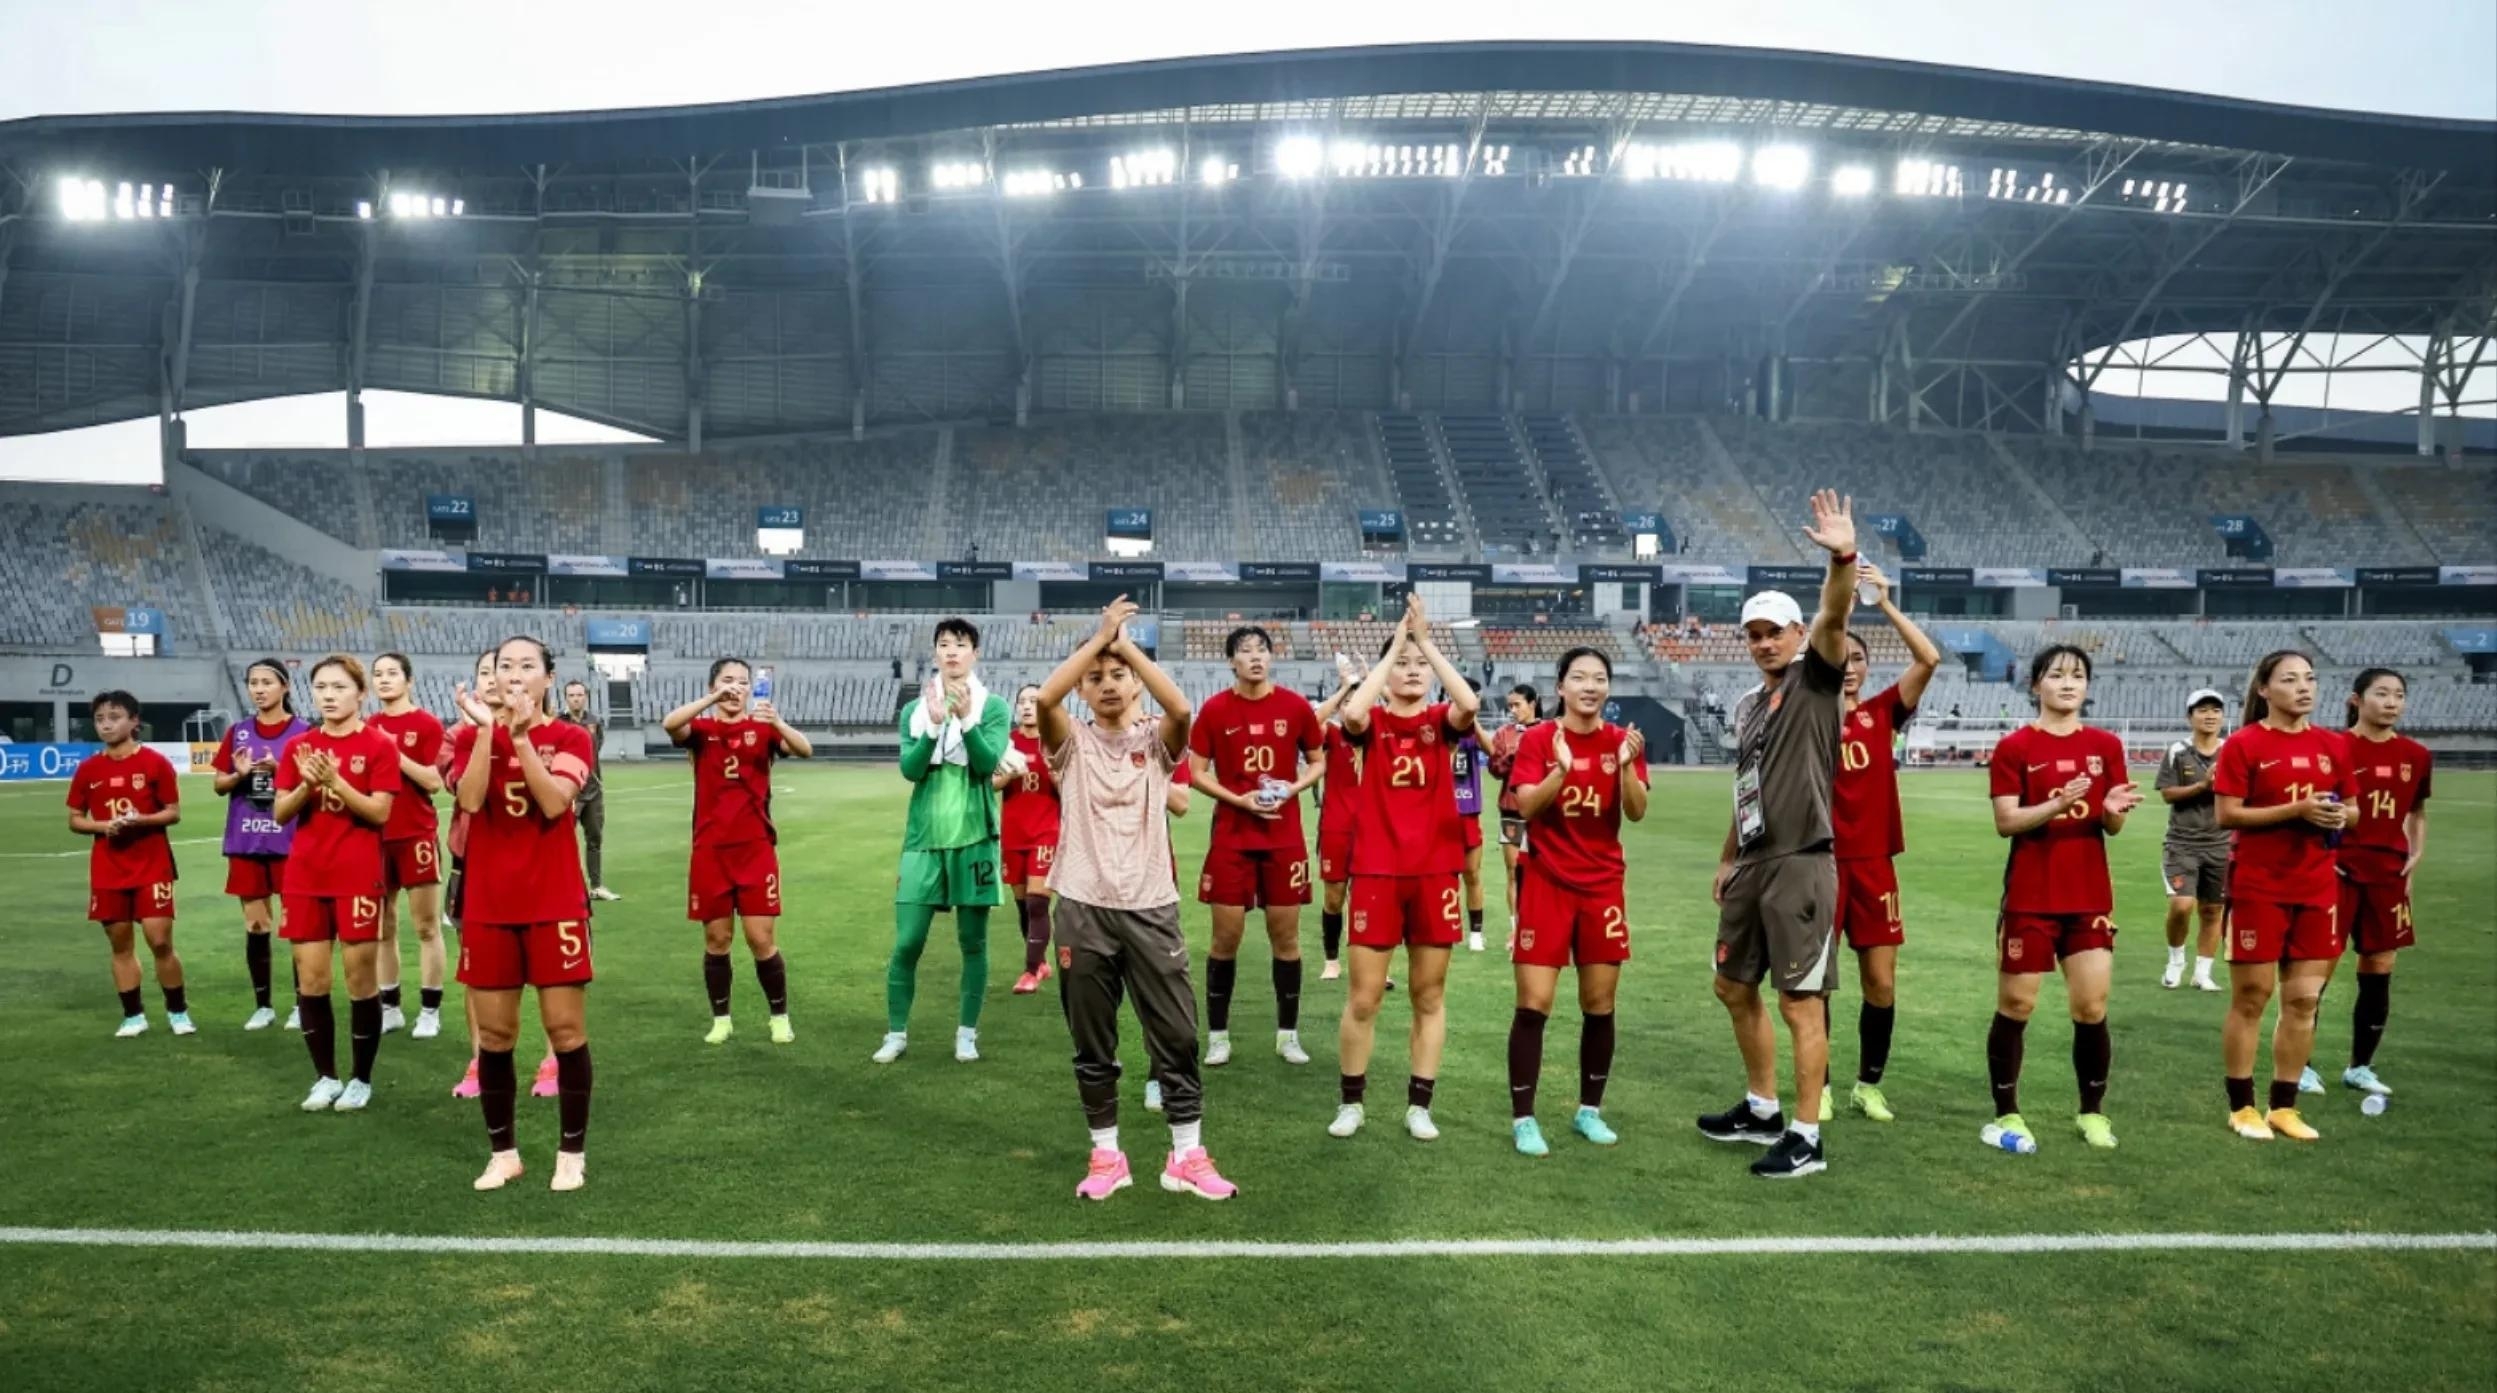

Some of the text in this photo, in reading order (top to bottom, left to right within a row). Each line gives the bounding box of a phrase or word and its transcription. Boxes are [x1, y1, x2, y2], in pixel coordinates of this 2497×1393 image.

[451, 499, 469, 514] 22
[782, 510, 800, 524] 23
[1130, 512, 1148, 526] 24
[1379, 513, 1396, 528] 25
[1639, 516, 1656, 529] 26
[1881, 518, 1898, 532] 27
[2226, 519, 2245, 533] 28
[128, 611, 150, 628] 19
[620, 624, 638, 638] 20
[50, 663, 73, 688] D
[724, 755, 739, 779] 2
[1244, 745, 1274, 772] 20
[1841, 740, 1870, 772] 10
[1022, 771, 1039, 792] 18
[1392, 755, 1425, 787] 21
[317, 787, 344, 812] 15
[504, 781, 528, 817] 5
[1562, 785, 1601, 818] 24
[2284, 781, 2314, 804] 11
[2368, 789, 2396, 819] 14
[104, 797, 131, 818] 19
[241, 819, 283, 833] 2025
[415, 841, 432, 865] 6
[1037, 845, 1054, 863] 18
[968, 860, 995, 887] 12
[153, 882, 172, 900] 19
[766, 873, 777, 899] 2
[353, 896, 377, 918] 15
[1441, 888, 1459, 920] 2
[1603, 905, 1625, 939] 2
[2391, 903, 2411, 931] 14
[557, 921, 581, 956] 5
